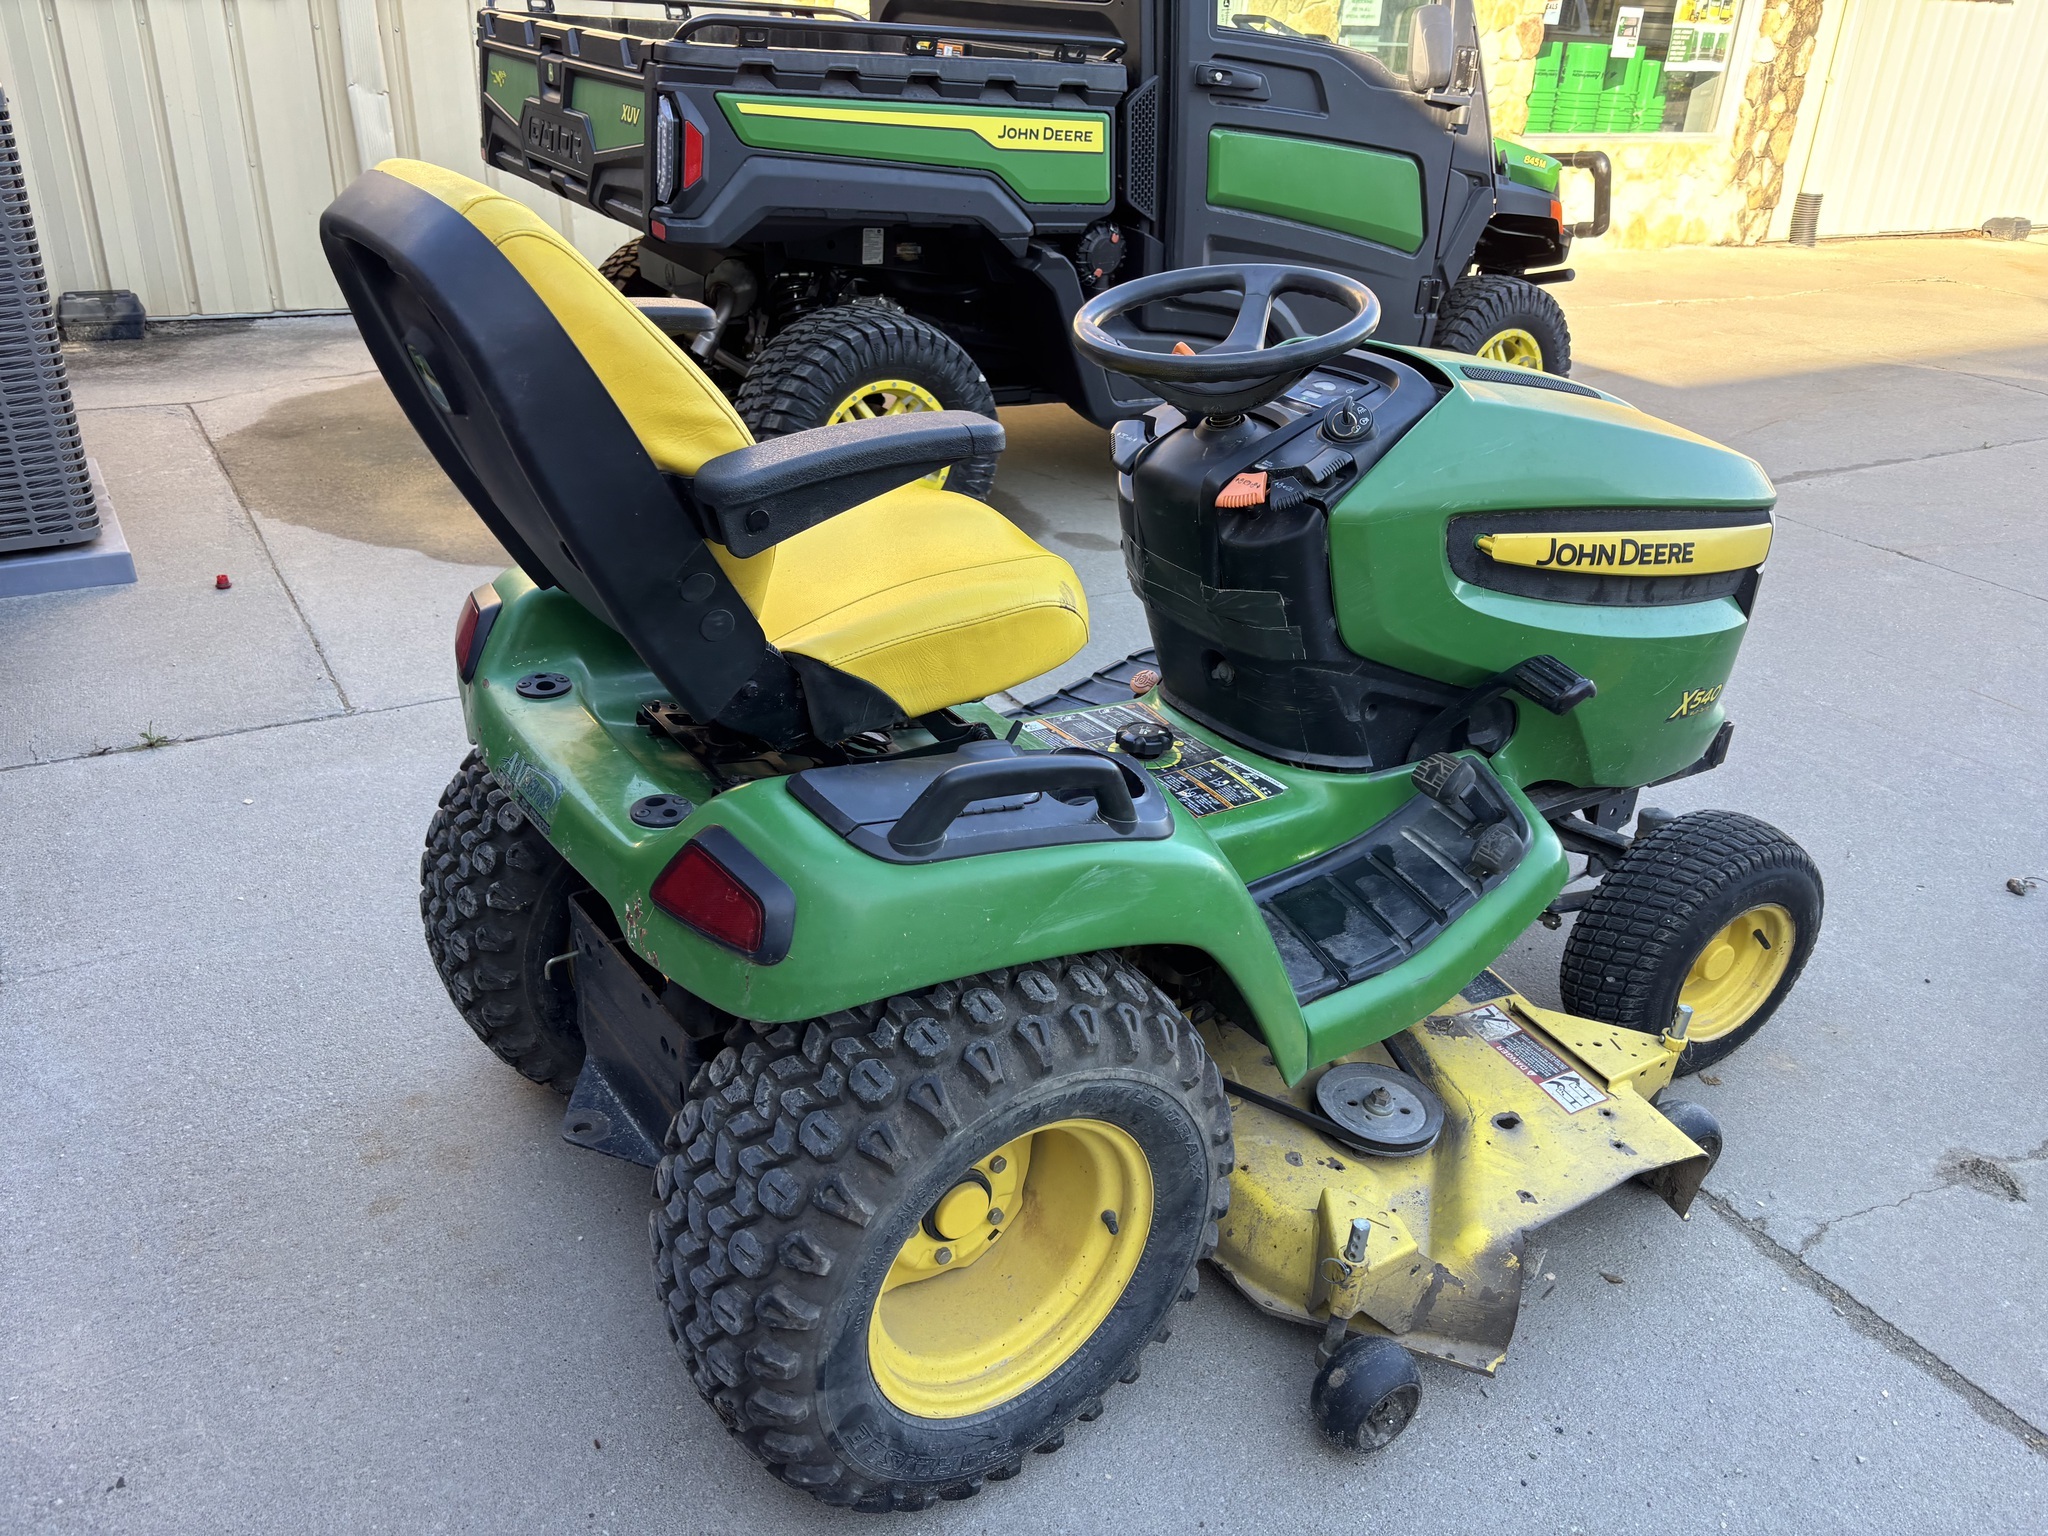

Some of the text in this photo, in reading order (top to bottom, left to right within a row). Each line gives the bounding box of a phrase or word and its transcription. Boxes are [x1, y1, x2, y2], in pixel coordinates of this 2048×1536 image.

[620, 103, 641, 126] XUV
[529, 117, 582, 163] GATOR
[998, 124, 1093, 142] JOHN DEERE
[1523, 154, 1547, 169] 845M
[1536, 537, 1696, 566] JOHN DEERE
[1666, 683, 1724, 721] X540
[1496, 1045, 1528, 1071] DANGER
[1163, 1105, 1205, 1186] TRAX
